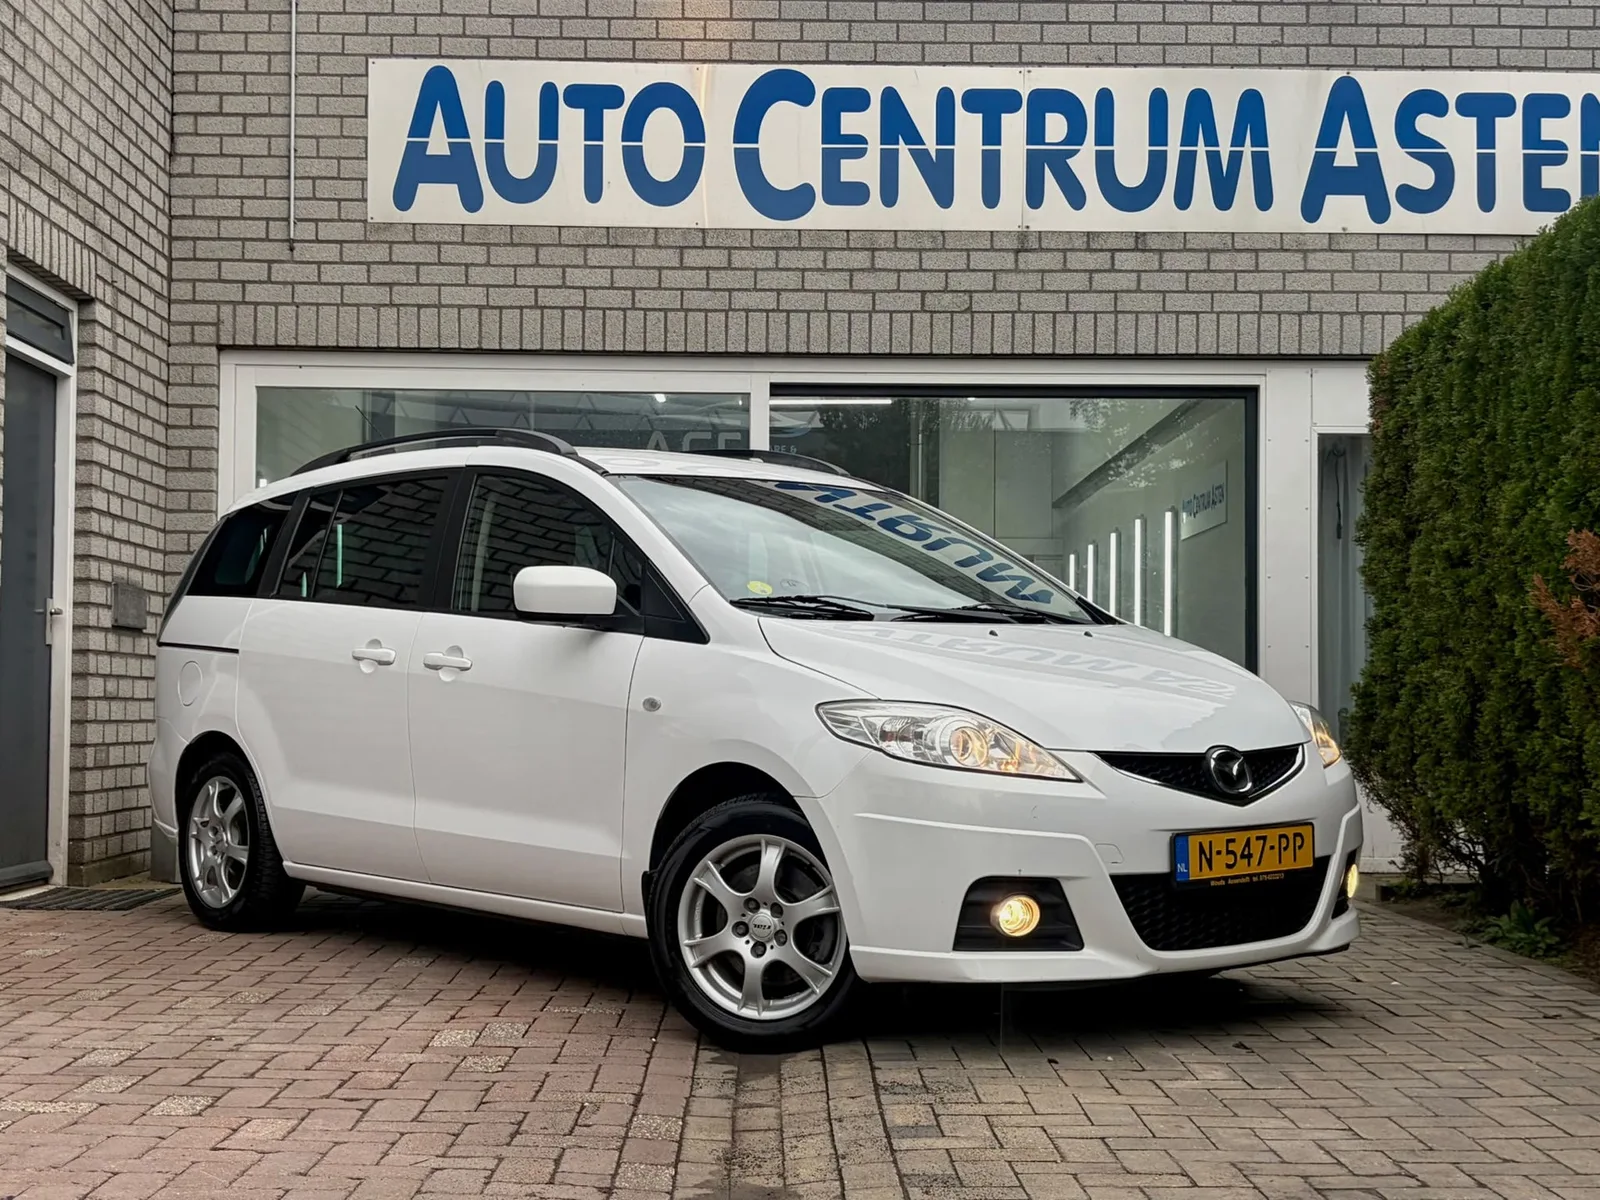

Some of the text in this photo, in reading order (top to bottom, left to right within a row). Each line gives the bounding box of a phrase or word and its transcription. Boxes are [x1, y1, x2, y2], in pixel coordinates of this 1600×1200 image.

[393, 65, 1600, 225] AUTO CENTRUM ASTE
[1177, 863, 1188, 873] NL
[1198, 832, 1305, 872] N-547-PP
